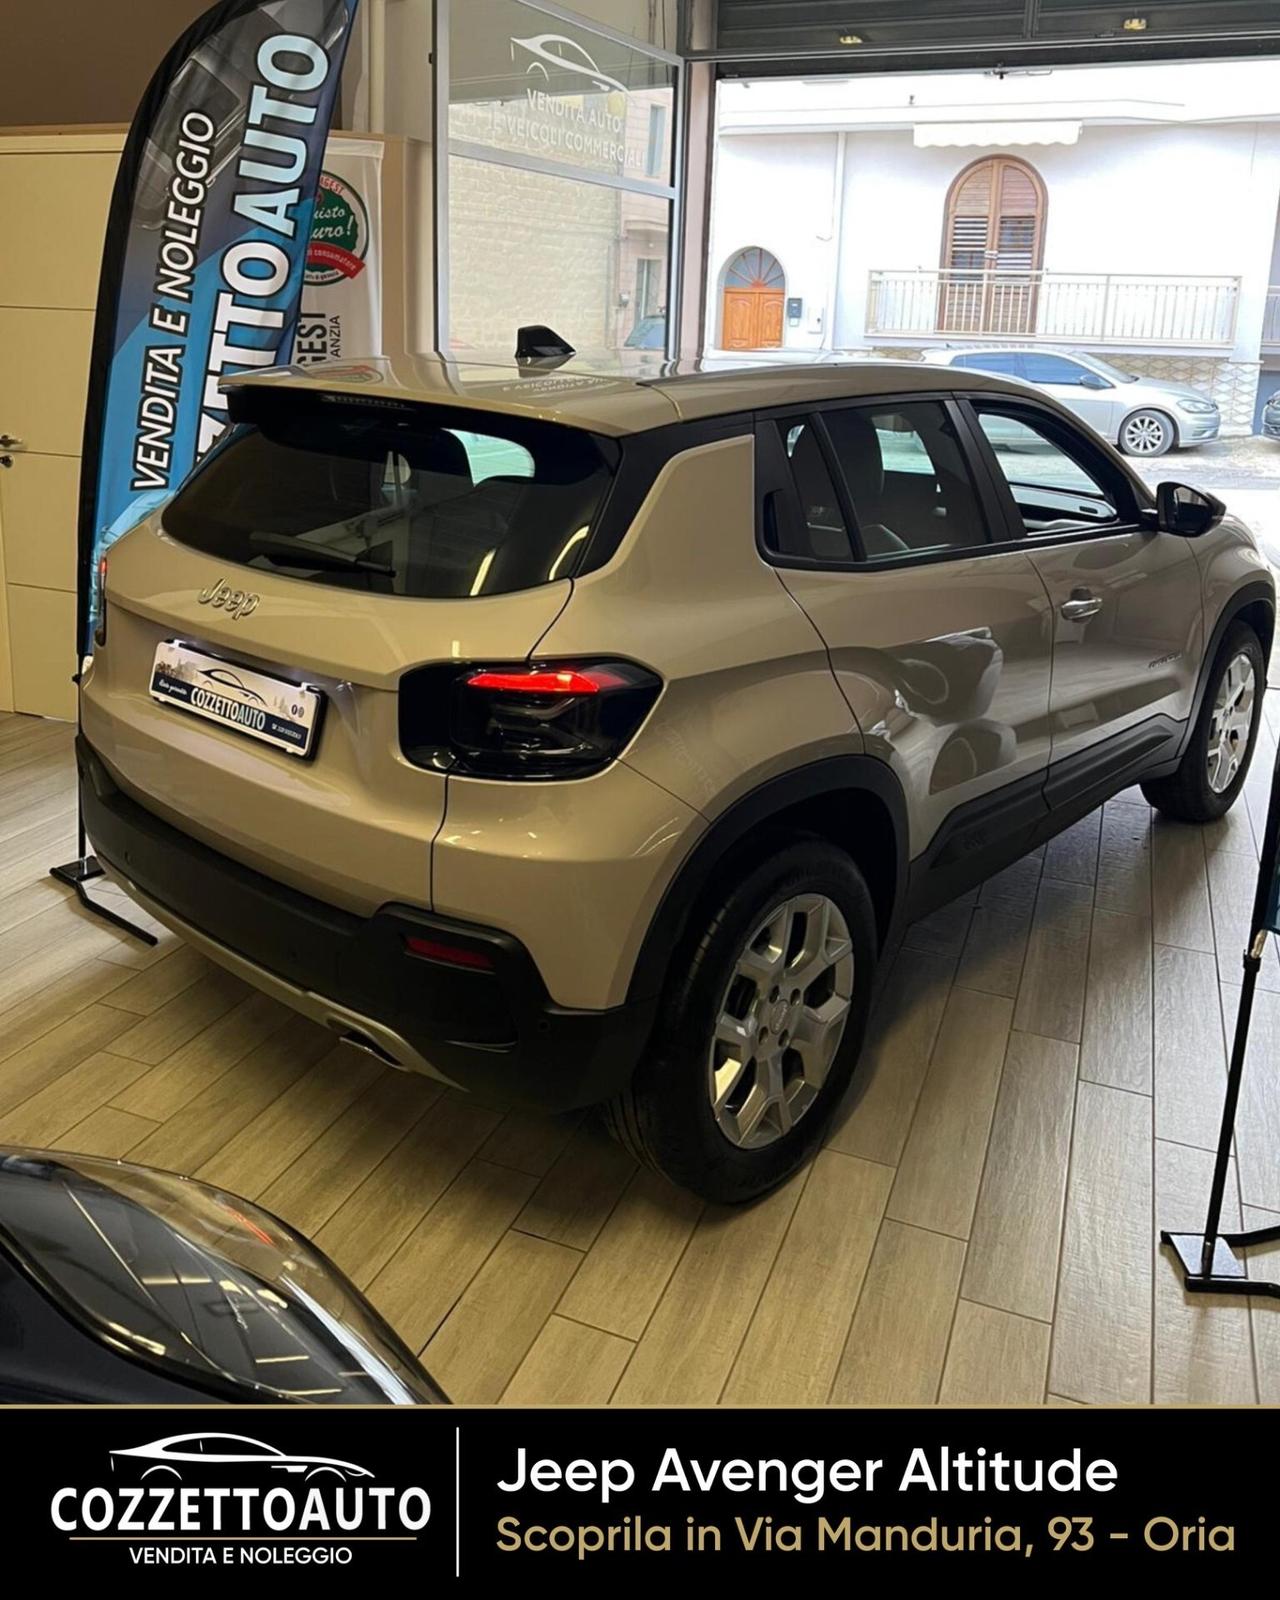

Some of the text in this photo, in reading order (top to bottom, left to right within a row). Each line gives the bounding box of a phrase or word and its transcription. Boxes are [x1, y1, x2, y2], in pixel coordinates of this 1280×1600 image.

[527, 88, 622, 133] VENDITA AUTO
[507, 115, 561, 146] VEICOLI
[564, 130, 645, 168] COMMERCIALI
[133, 110, 215, 490] VENDITA E NOLEGGIO
[198, 577, 260, 620] Jeep
[190, 687, 266, 731] COZZETTOAUTO
